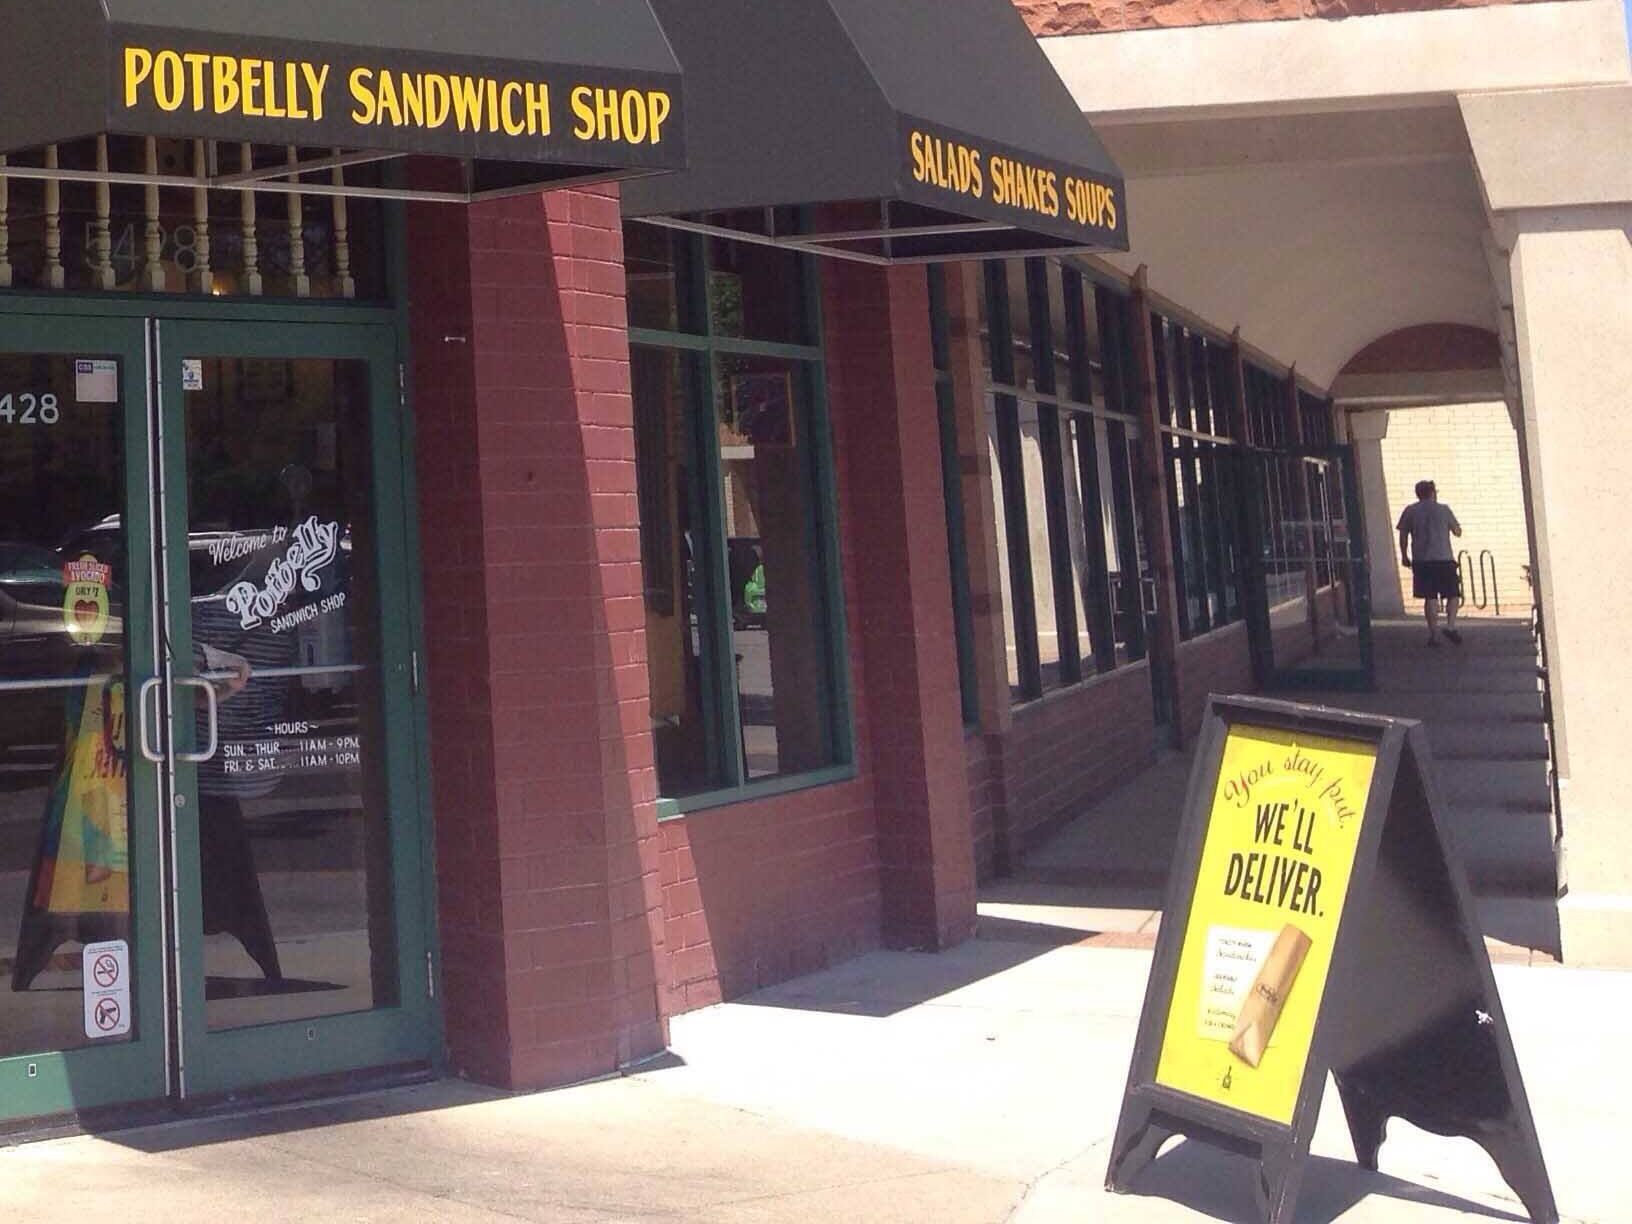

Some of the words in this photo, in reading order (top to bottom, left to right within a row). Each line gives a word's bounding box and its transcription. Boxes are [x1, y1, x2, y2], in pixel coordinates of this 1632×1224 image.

[125, 47, 329, 121] POTBELLY
[349, 67, 551, 137] SANDWICH
[570, 85, 670, 144] SHOP
[911, 131, 983, 199] SALADS
[990, 156, 1059, 217] SHAKES
[1065, 177, 1116, 231] SOUPS
[209, 534, 267, 566] Welcome
[272, 524, 287, 544] to
[270, 603, 318, 634] SANDWICH
[321, 592, 346, 614] SHOP
[1224, 760, 1274, 808] You
[1255, 798, 1315, 855] WE'LL
[1224, 852, 1324, 917] DELIVER.
